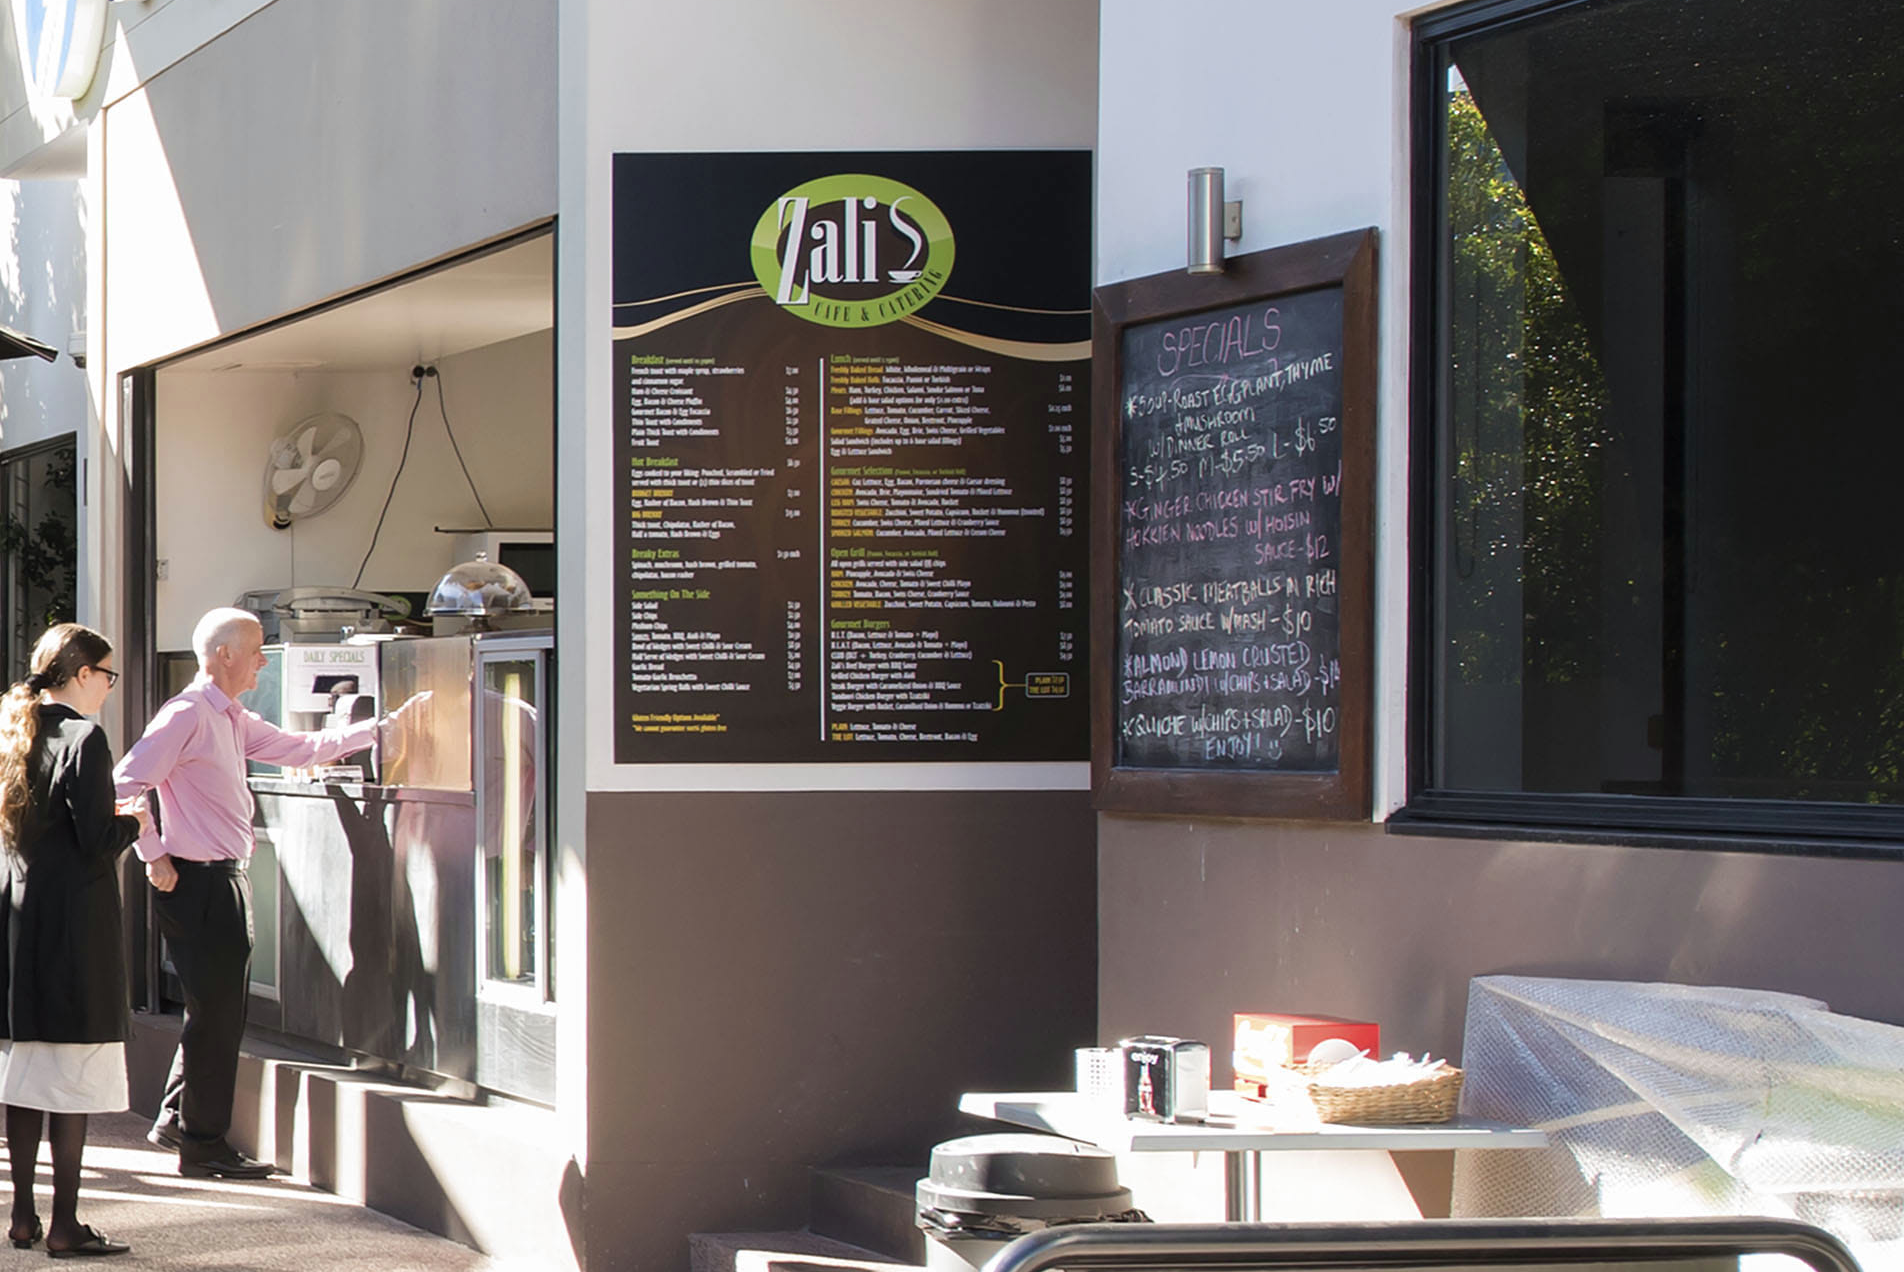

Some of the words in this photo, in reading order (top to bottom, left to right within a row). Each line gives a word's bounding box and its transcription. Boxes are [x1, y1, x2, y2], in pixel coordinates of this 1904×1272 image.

[861, 306, 871, 322] &
[878, 268, 943, 319] CATERING
[1157, 307, 1281, 376] SPECIALS
[1196, 489, 1248, 511] CHICKEN
[1252, 484, 1288, 506] STIR
[1289, 477, 1316, 501] FRY
[1140, 582, 1197, 609] CLASSIC
[1203, 577, 1281, 605] MEATBALLS
[1306, 569, 1336, 598] RICH
[1178, 612, 1215, 632] SAUCE
[329, 650, 365, 663] SPECIALS
[1193, 648, 1236, 671] LEMON
[1243, 641, 1311, 670] CRUSTED
